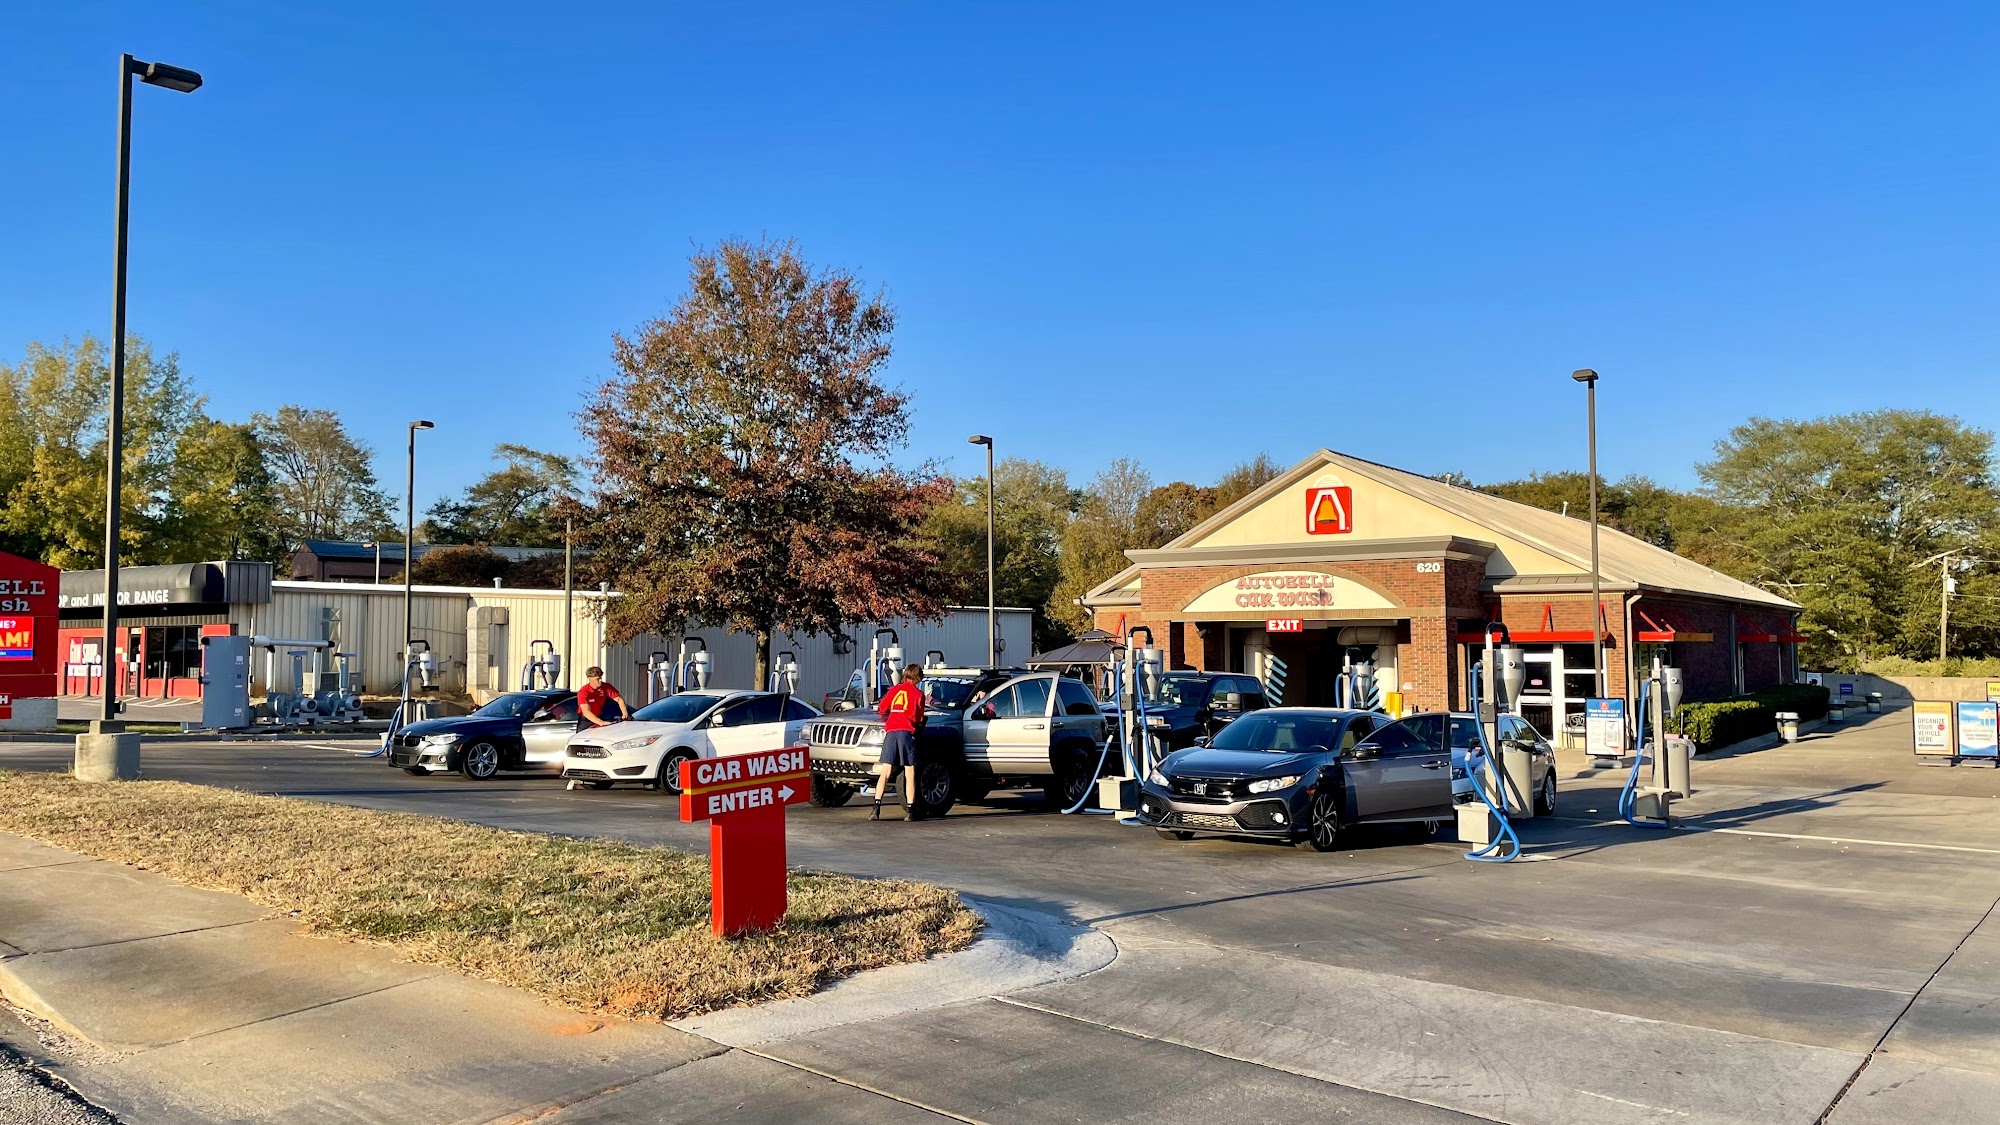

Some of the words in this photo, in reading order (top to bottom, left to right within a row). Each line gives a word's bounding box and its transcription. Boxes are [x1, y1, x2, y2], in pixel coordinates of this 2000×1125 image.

[1416, 562, 1440, 573] 620
[1236, 575, 1334, 589] AUTOBELL
[71, 593, 89, 607] and
[93, 591, 130, 606] INOR
[134, 589, 169, 604] RANGE
[1268, 620, 1300, 631] EXIT
[697, 760, 741, 784] CAR
[747, 751, 804, 776] WASH
[708, 787, 773, 815] ENTER
